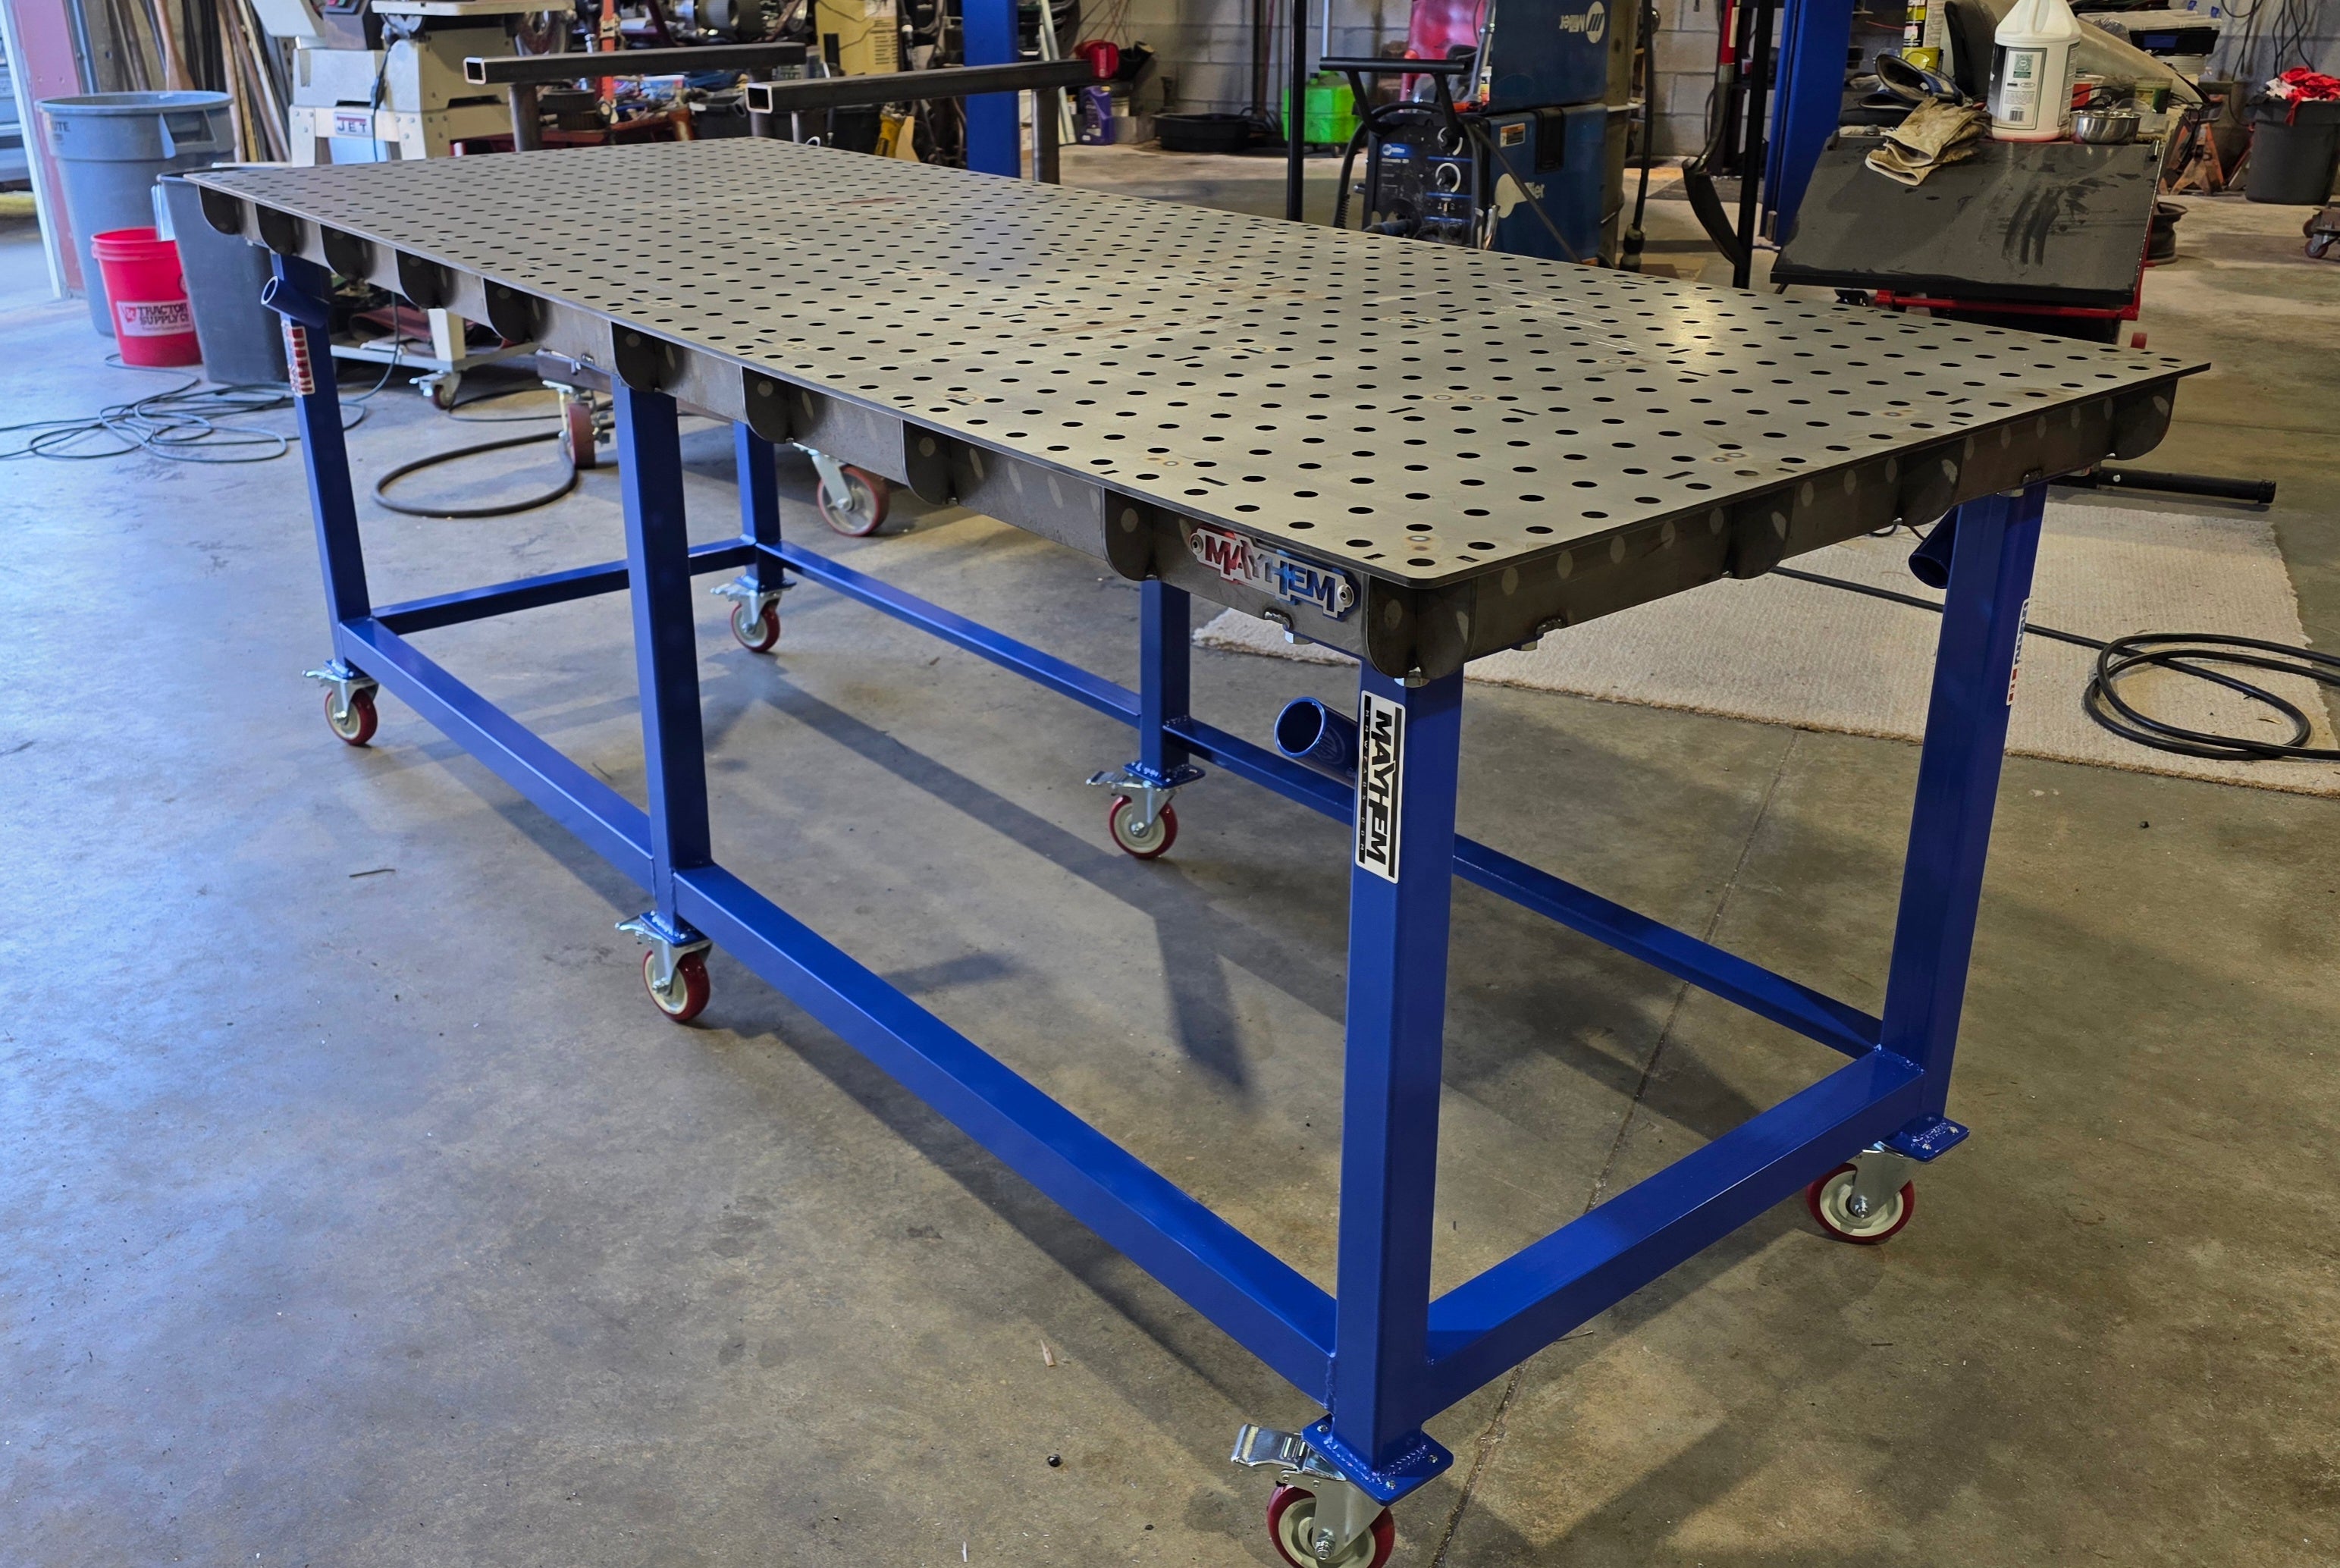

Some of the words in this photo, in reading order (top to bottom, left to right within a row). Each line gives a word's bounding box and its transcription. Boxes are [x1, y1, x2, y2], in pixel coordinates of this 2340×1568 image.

[337, 118, 367, 133] JET
[138, 303, 188, 315] TRACTOR
[140, 314, 179, 325] SUPPLY
[1205, 535, 1336, 613] MAYHEM
[1366, 710, 1395, 865] MAYHEM
